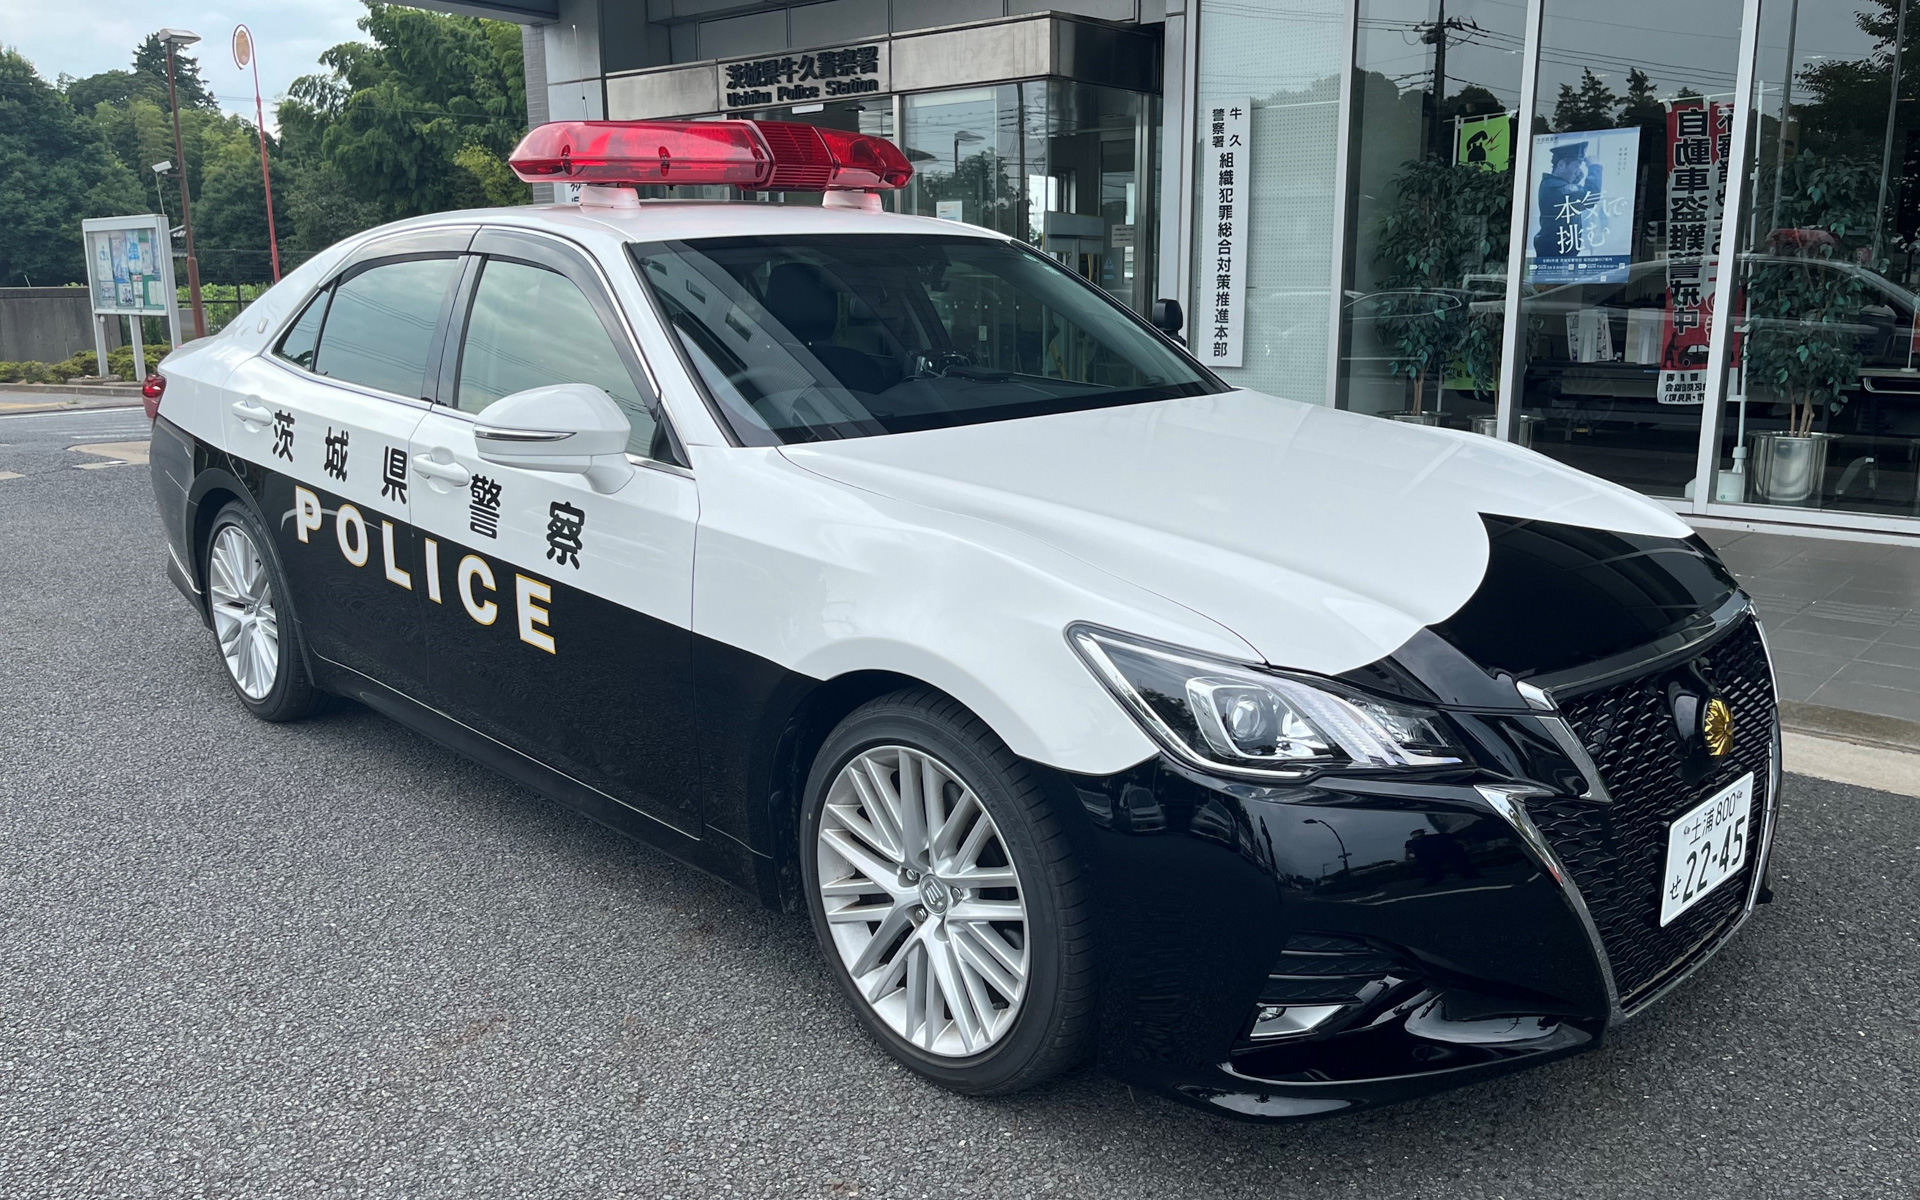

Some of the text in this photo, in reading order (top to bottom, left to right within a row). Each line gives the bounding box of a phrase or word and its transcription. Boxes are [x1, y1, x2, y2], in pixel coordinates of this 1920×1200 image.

[725, 46, 879, 89] 茨城県牛久警察署
[727, 78, 879, 107] Ushiku Police Station
[1212, 108, 1225, 148] 警察署
[1229, 107, 1242, 147] 牛久
[1554, 191, 1627, 224] 本気で
[1213, 152, 1234, 357] 組織犯罪総合対策推進本部
[1556, 222, 1610, 254] 挑む
[272, 409, 586, 570] 茨城県警察
[295, 485, 557, 655] POLICE
[1690, 792, 1736, 845] 土浦 800
[1670, 815, 1746, 904] せ 22-45
